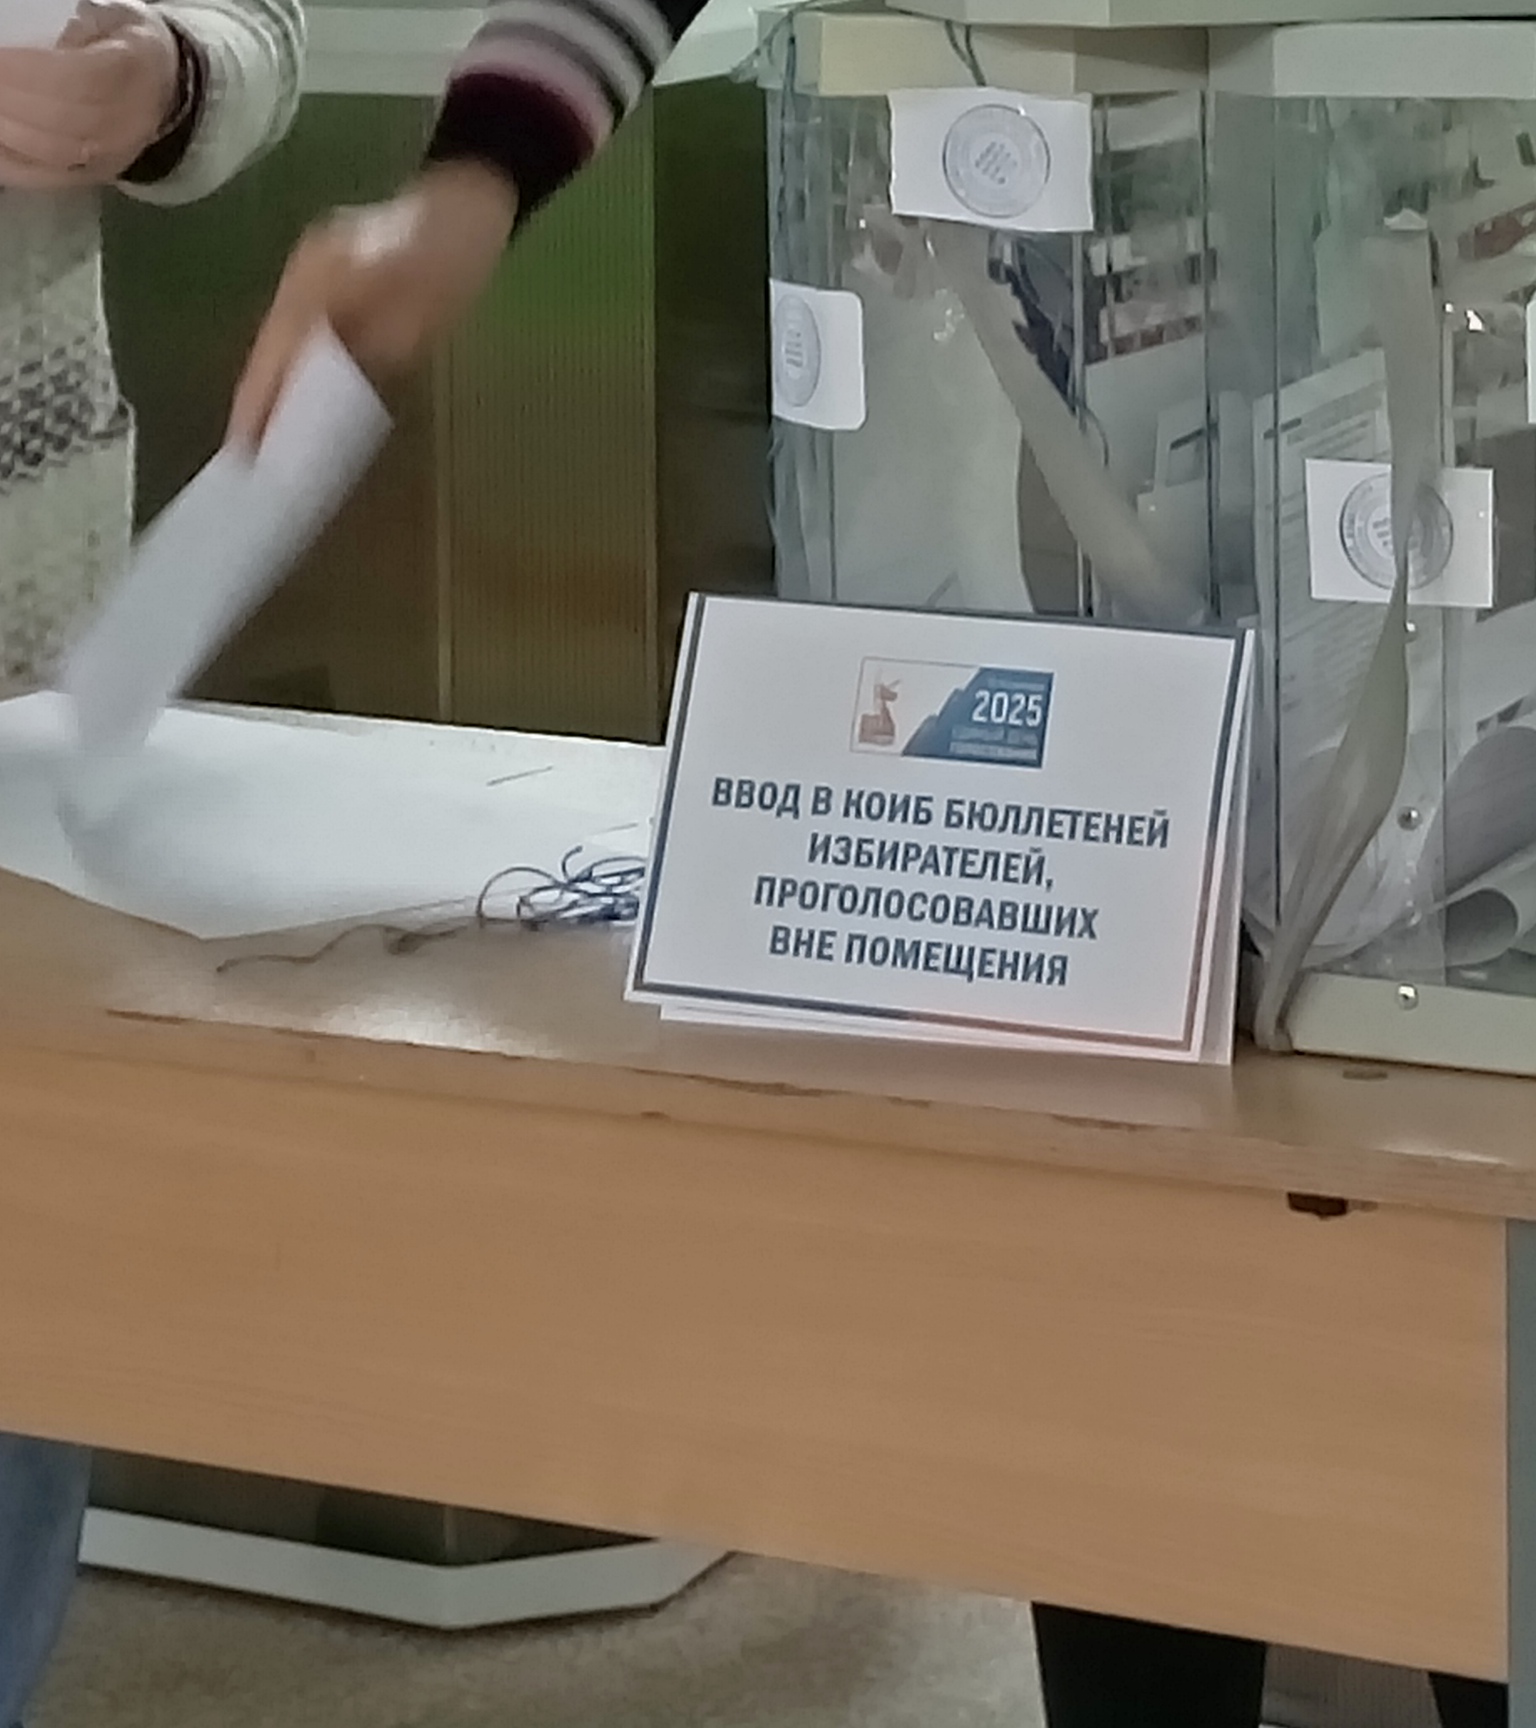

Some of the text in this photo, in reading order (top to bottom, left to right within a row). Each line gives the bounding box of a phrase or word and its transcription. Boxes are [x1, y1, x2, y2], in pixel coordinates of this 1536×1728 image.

[972, 690, 1043, 728] 2025
[712, 776, 1170, 849] ВВОД В КОИБ БЮЛЛЕТЕНЕЙ
[808, 832, 1053, 892] ИЗБИРАТЕЛЕЙ,
[754, 875, 1099, 940] ПРОГОЛОСОВАВШИХ
[769, 925, 1068, 986] ВНЕ ПОМЕЩЕНИЯ
